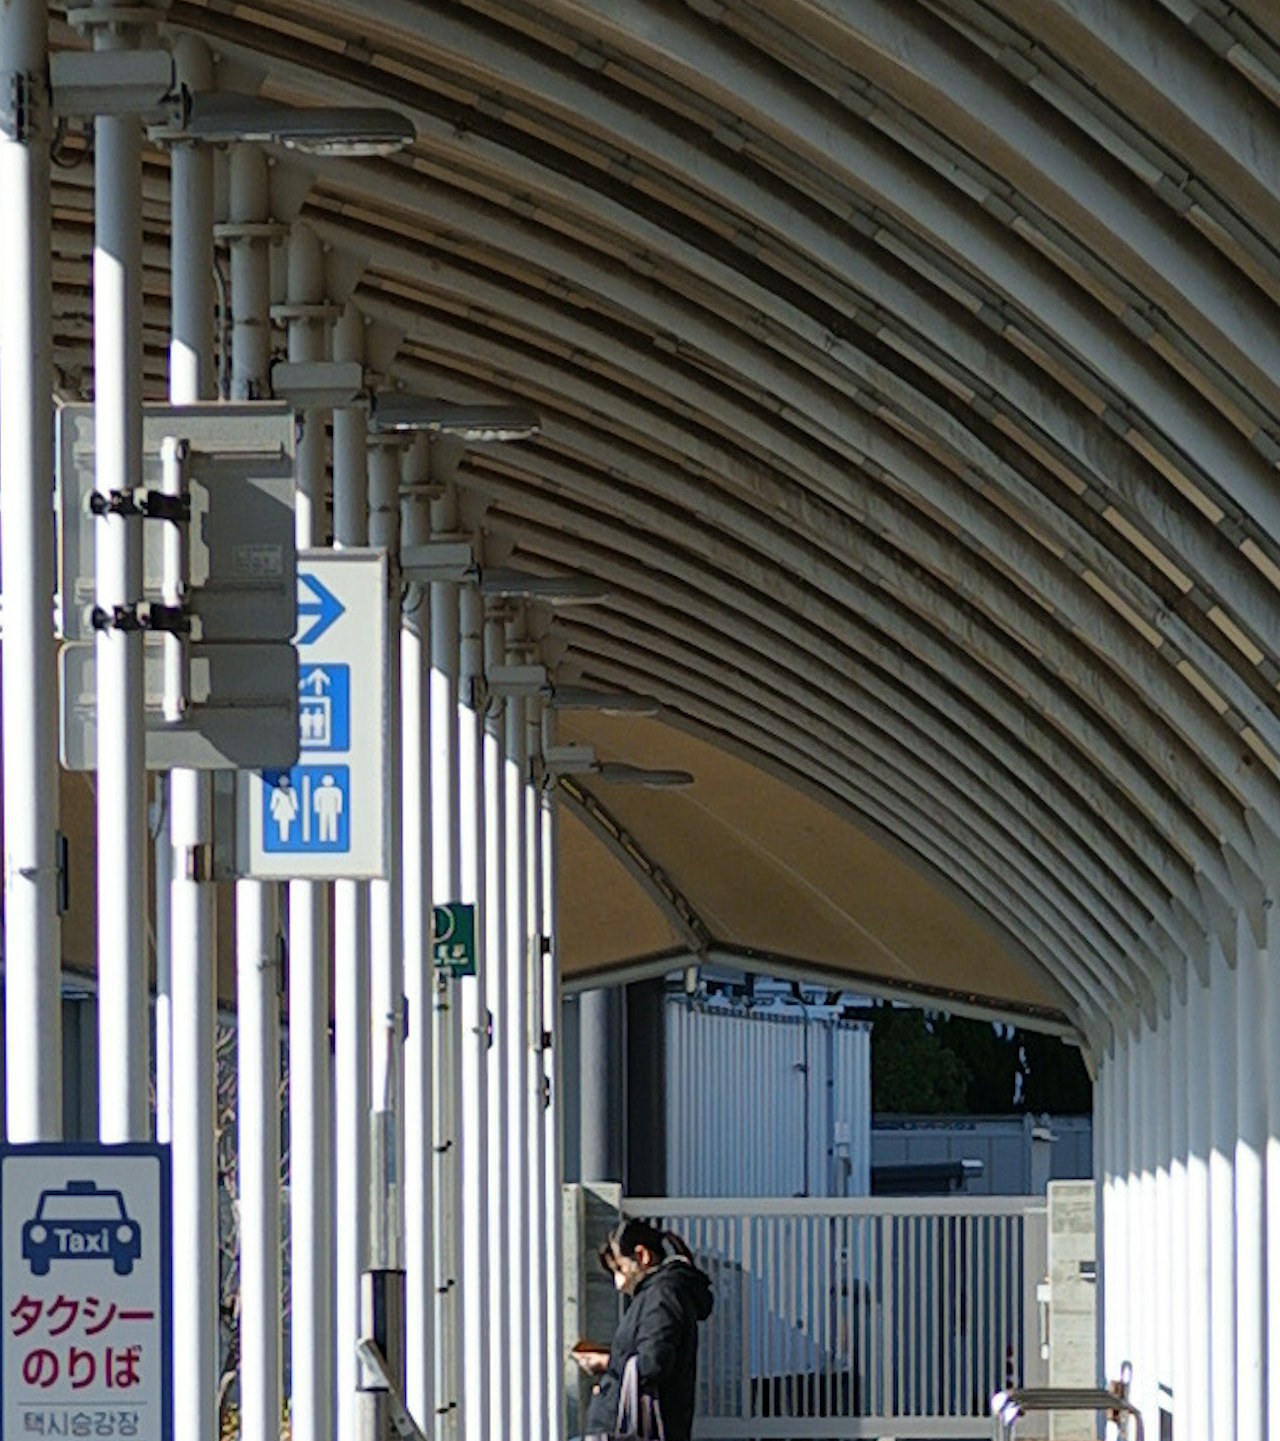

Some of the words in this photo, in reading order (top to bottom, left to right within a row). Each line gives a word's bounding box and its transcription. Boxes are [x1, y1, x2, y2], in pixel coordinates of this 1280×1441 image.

[53, 1227, 110, 1253] Taxi
[10, 1294, 154, 1337] タクシー
[22, 1344, 143, 1389] のりば
[23, 1410, 140, 1437] 택시승강장
